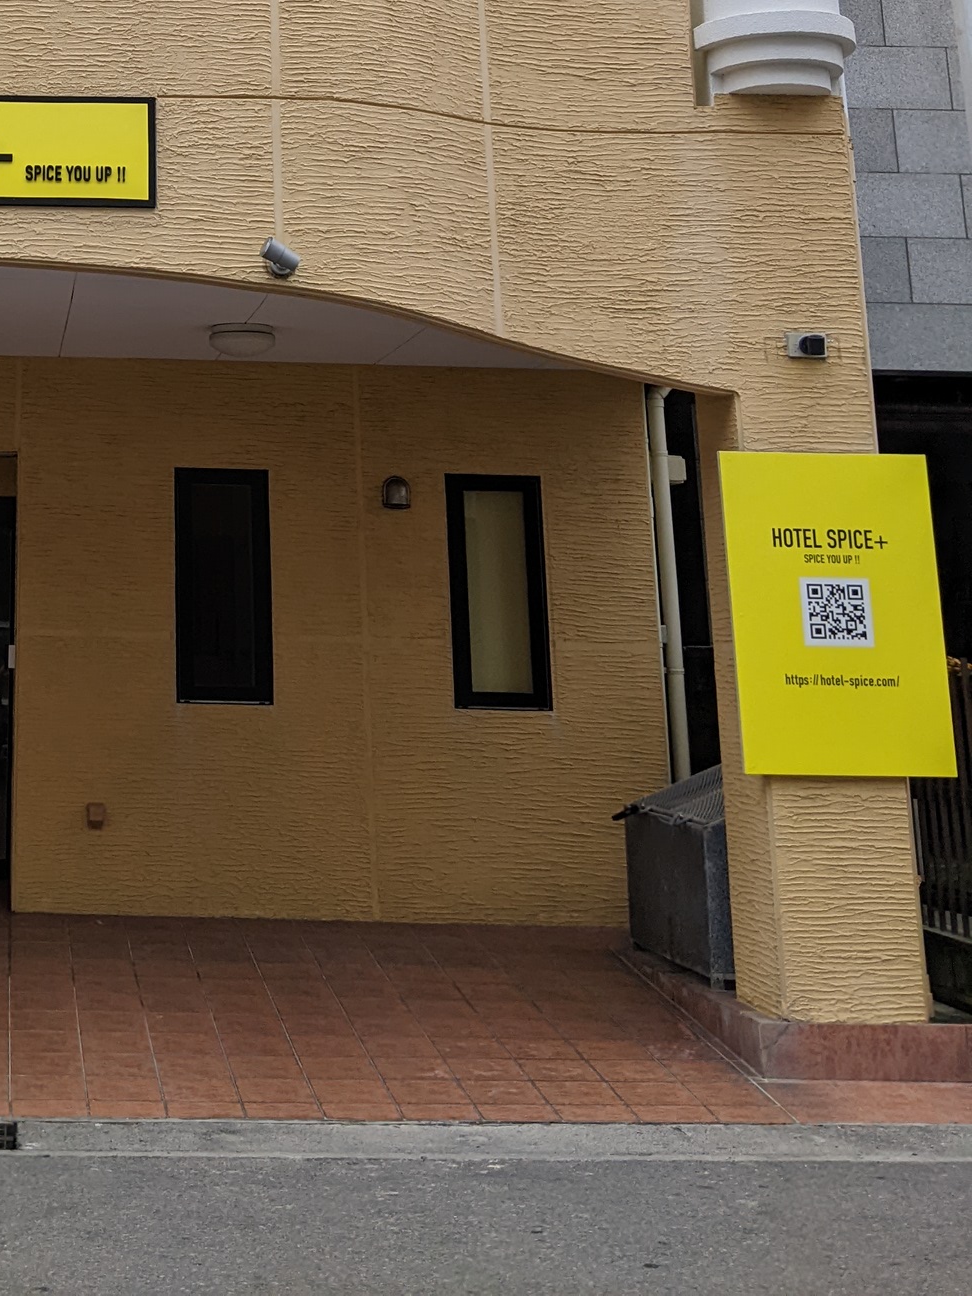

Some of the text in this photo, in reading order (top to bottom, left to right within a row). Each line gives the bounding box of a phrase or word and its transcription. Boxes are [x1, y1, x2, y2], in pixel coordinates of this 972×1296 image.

[25, 165, 62, 182] SPICE
[66, 165, 91, 182] YOU
[96, 166, 112, 183] UP
[772, 528, 888, 549] HOTEL SPICE+
[804, 554, 825, 564] SPICE
[826, 554, 841, 564] YOU
[843, 555, 852, 564] UP
